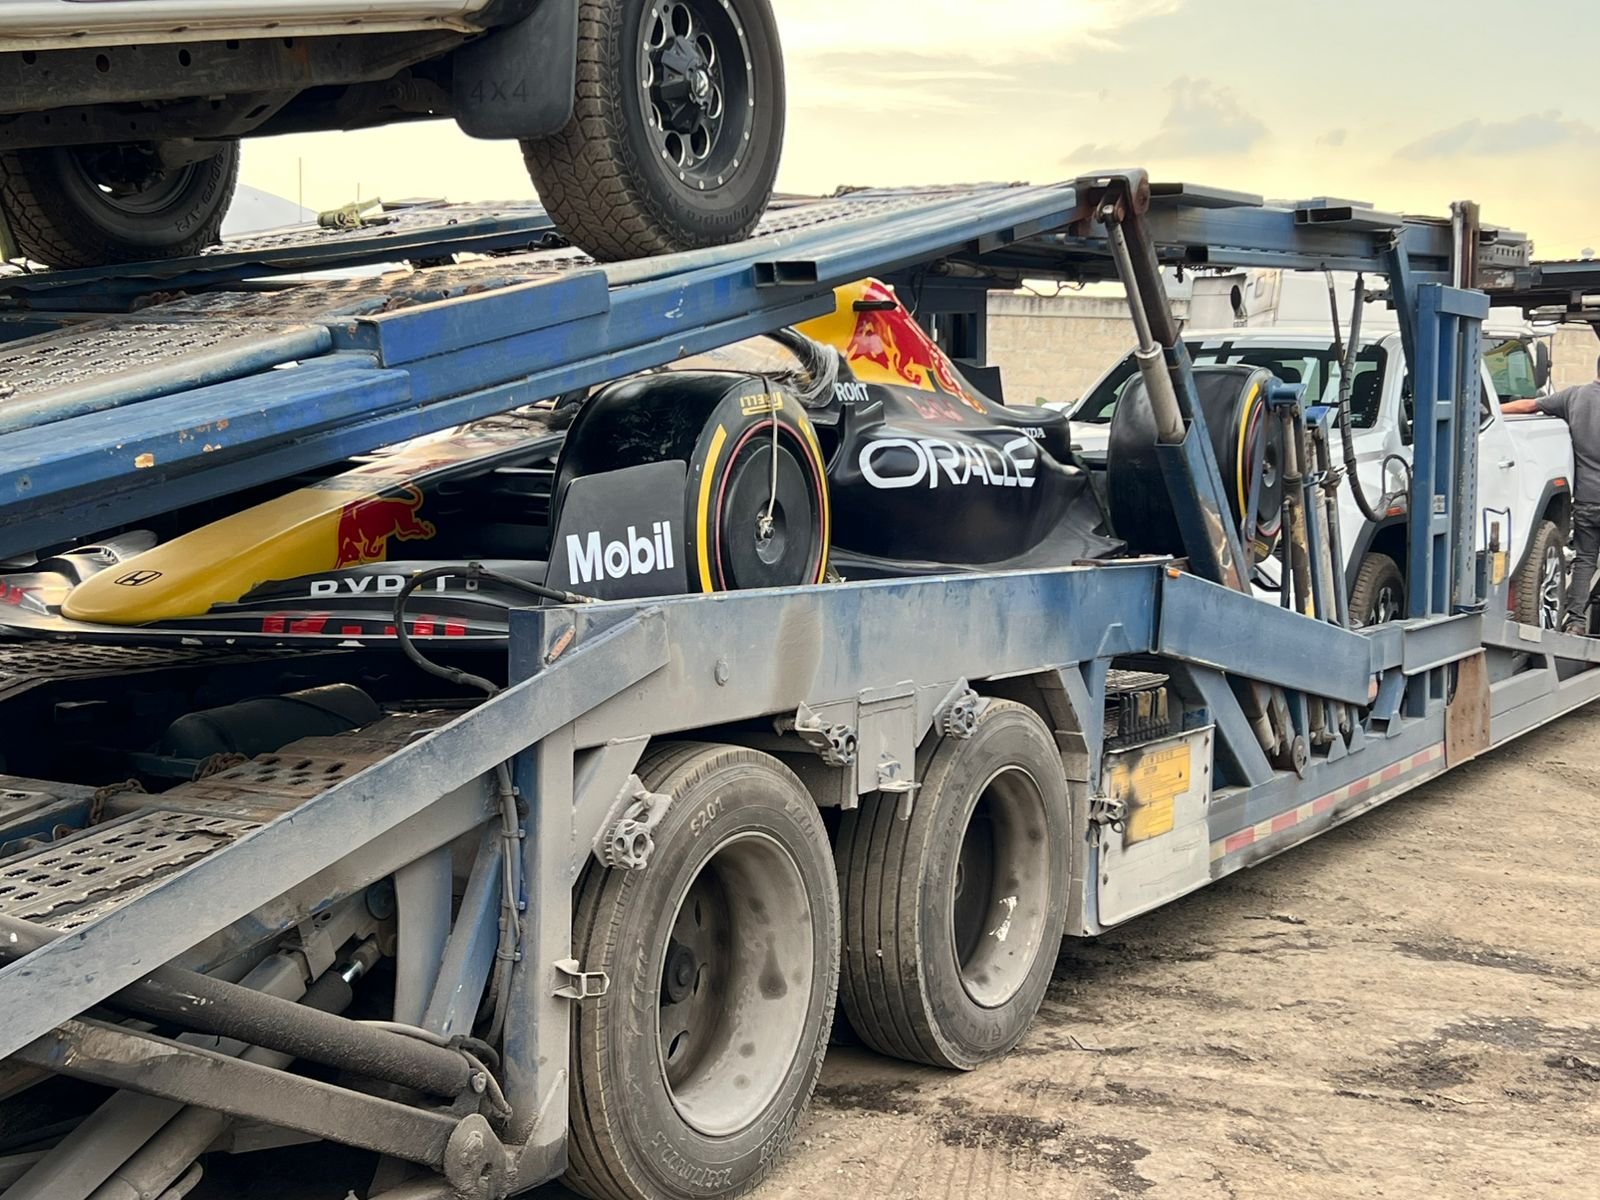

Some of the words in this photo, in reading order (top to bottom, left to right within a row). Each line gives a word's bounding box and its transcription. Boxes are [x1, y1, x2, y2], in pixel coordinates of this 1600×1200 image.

[835, 381, 870, 401] ROKT
[859, 438, 1036, 489] ORACLE
[566, 520, 674, 585] Mobil
[689, 795, 726, 838] S201
